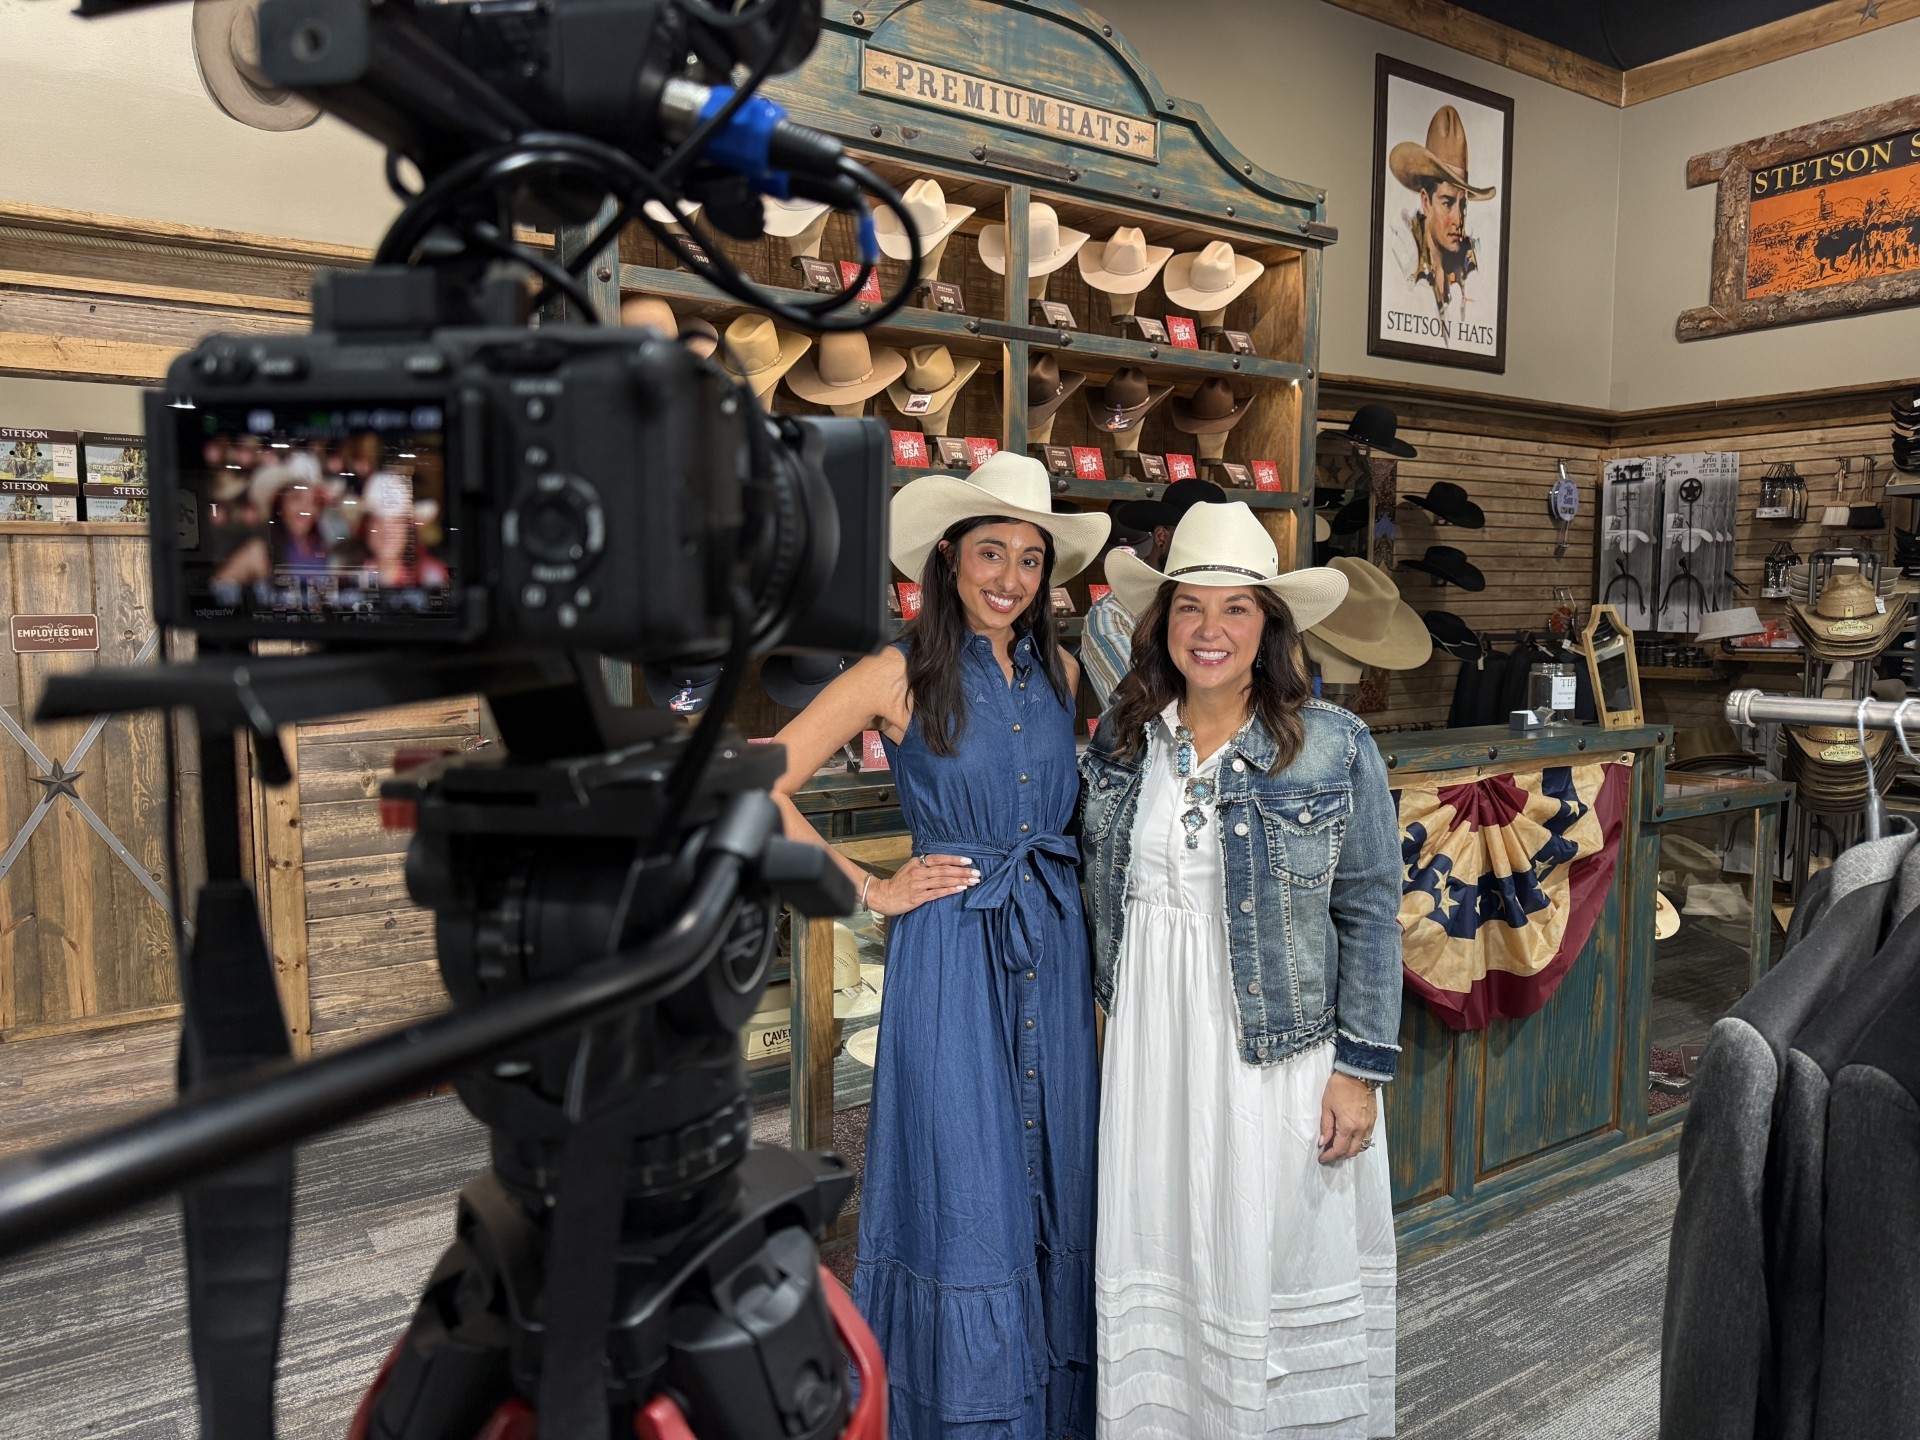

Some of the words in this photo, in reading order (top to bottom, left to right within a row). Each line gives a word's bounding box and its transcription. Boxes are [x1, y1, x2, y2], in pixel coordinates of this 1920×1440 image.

[895, 60, 1049, 127] PREMIUM
[1056, 103, 1131, 147] HATS
[1754, 140, 1895, 195] STETSON
[1386, 310, 1453, 339] STETSON
[1457, 322, 1494, 346] HATS
[1177, 331, 1190, 341] USA
[1, 428, 49, 439] STETSON
[903, 448, 919, 459] USA
[1084, 461, 1098, 472] USA
[1177, 467, 1190, 479] USA
[1262, 474, 1274, 484] USA
[2, 481, 49, 492] STETSON
[113, 486, 149, 496] STETSO
[17, 628, 70, 638] EMPLOYEES
[71, 628, 94, 637] ONLY
[1560, 678, 1576, 688] TIP
[874, 748, 886, 758] US
[762, 1027, 792, 1048] CAVE
